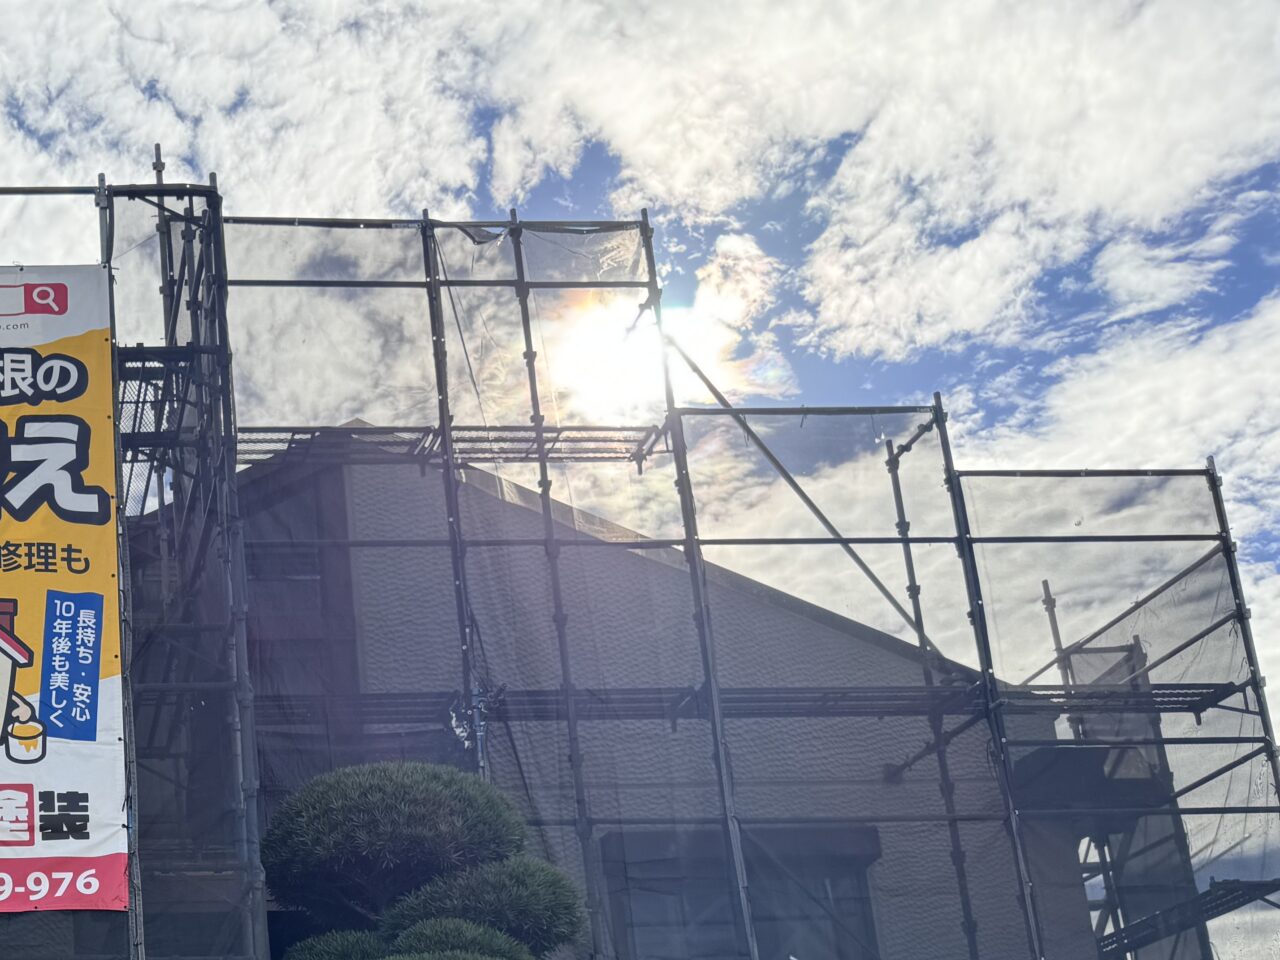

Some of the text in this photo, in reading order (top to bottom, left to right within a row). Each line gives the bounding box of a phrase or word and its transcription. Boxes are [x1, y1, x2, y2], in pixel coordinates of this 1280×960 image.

[49, 600, 75, 728] 10年後も美しく
[71, 609, 97, 722] 長持ち・安心
